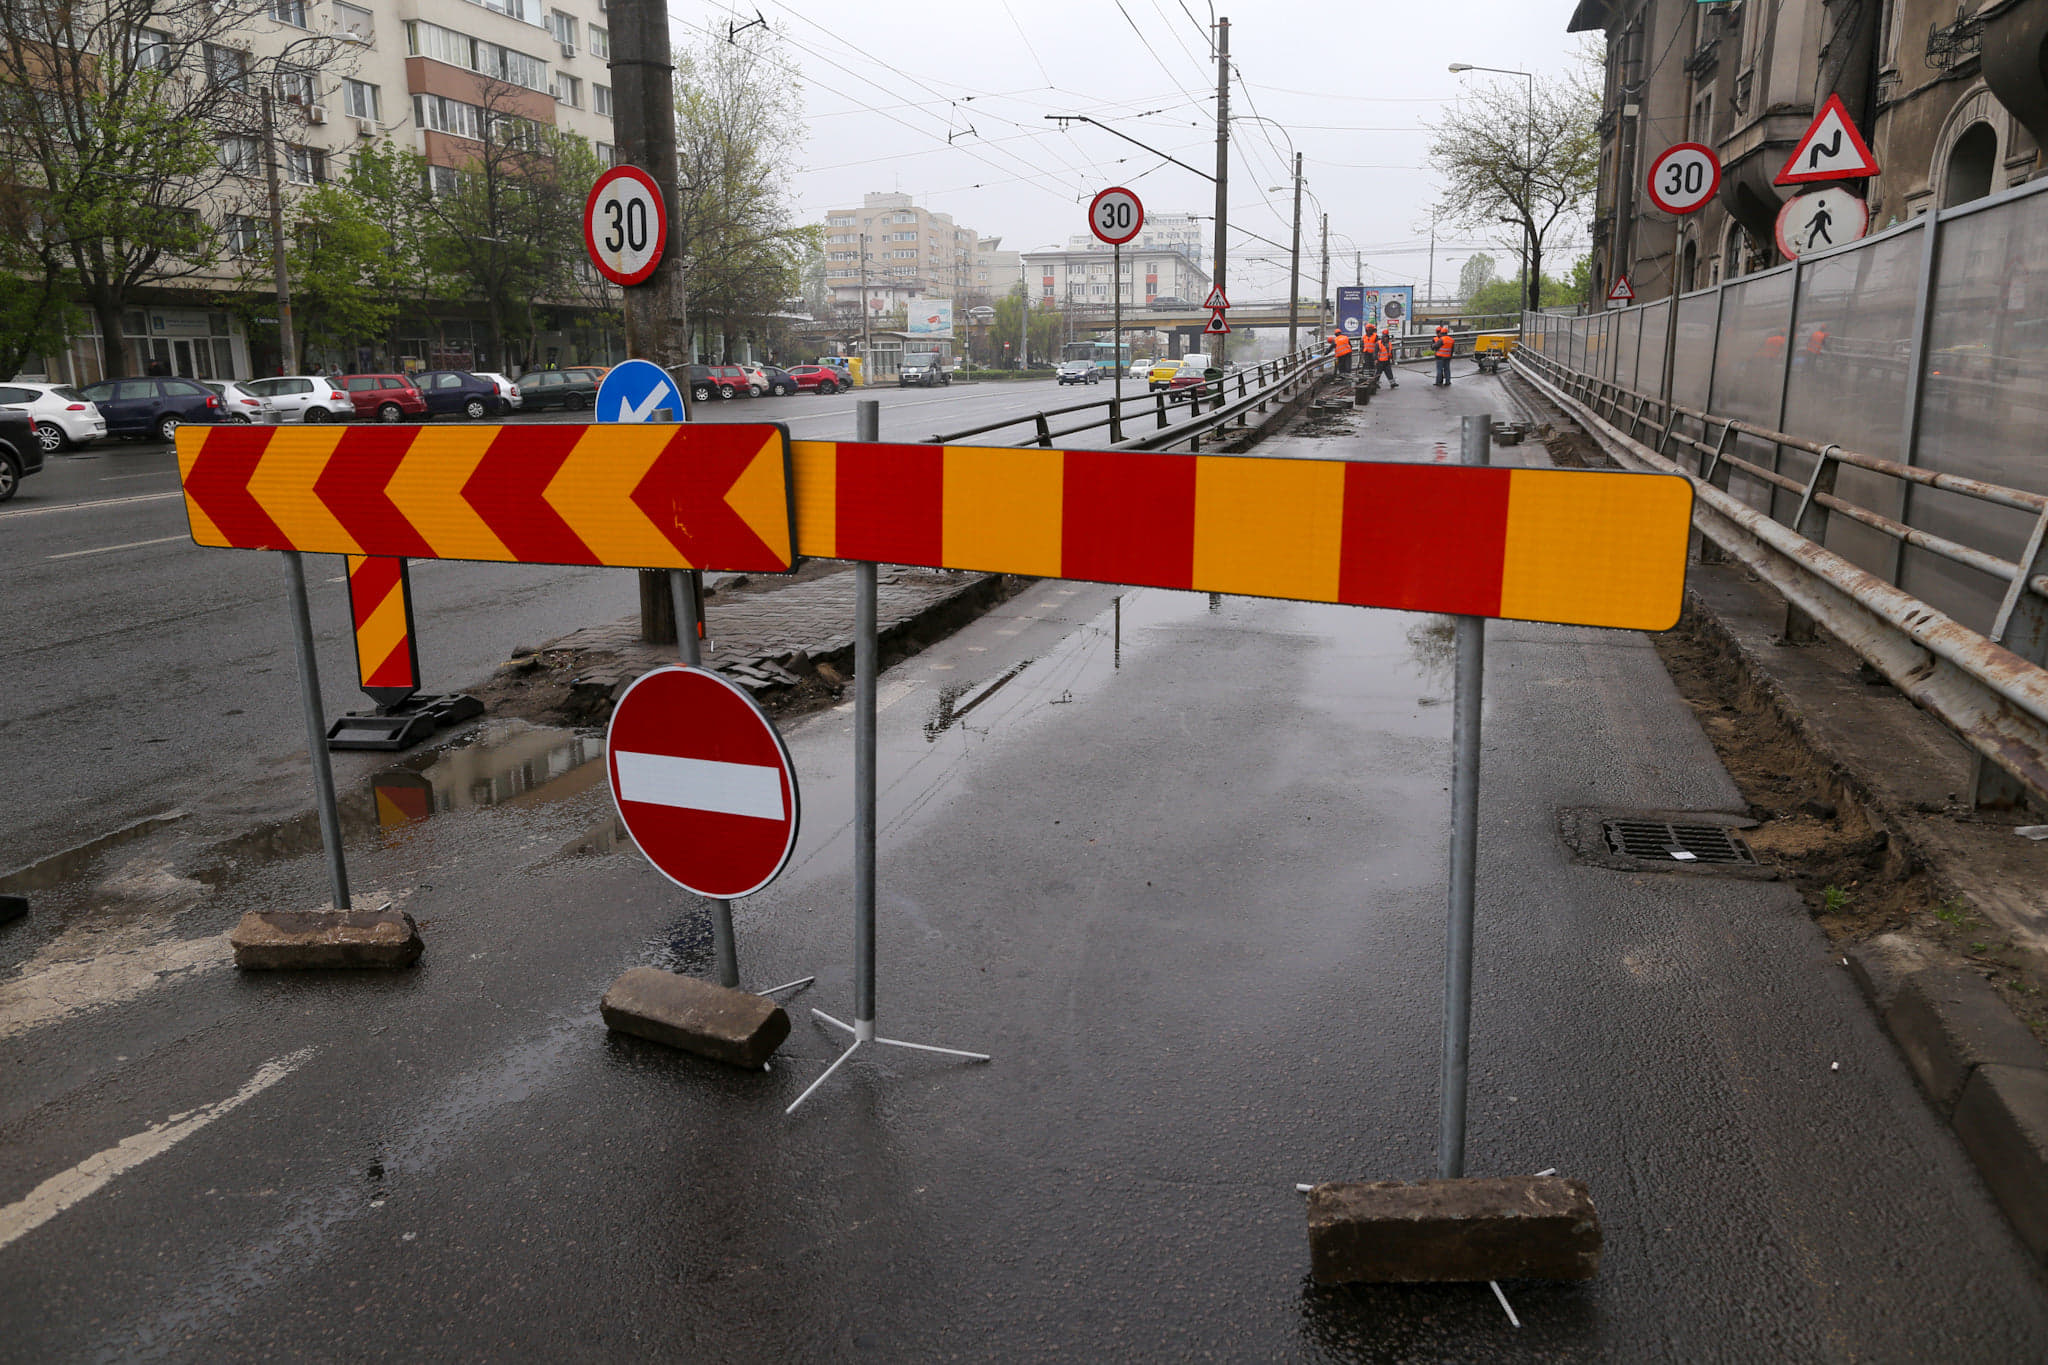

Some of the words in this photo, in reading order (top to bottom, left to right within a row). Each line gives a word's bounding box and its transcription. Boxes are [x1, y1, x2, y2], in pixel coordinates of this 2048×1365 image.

[1665, 161, 1703, 195] 30
[605, 197, 647, 252] 30
[1102, 203, 1130, 228] 30
